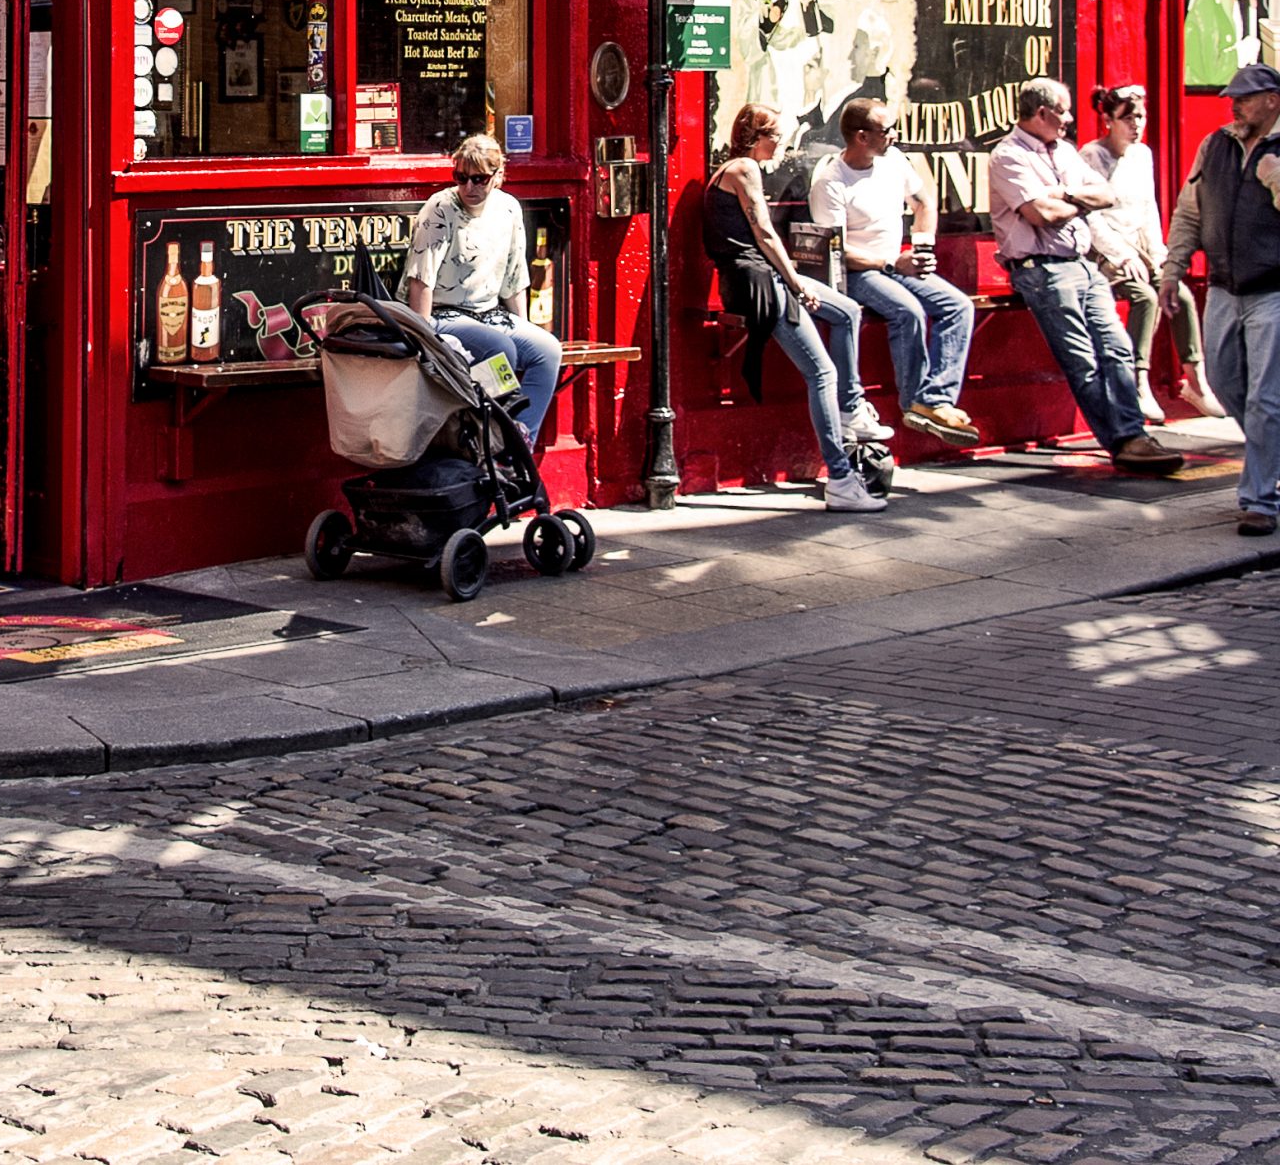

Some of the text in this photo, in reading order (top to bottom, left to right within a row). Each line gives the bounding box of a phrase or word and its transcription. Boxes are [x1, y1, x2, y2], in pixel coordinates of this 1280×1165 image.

[395, 9, 443, 23] Charcuterie
[445, 10, 471, 26] Meats,
[407, 27, 439, 41] Toasted
[404, 45, 421, 58] Hot
[422, 45, 445, 58] Roast
[447, 46, 466, 58] Beef
[1024, 35, 1053, 76] OF
[896, 80, 1028, 145] ALTED LIQU
[226, 218, 296, 255] THE
[333, 253, 400, 276] DULIN
